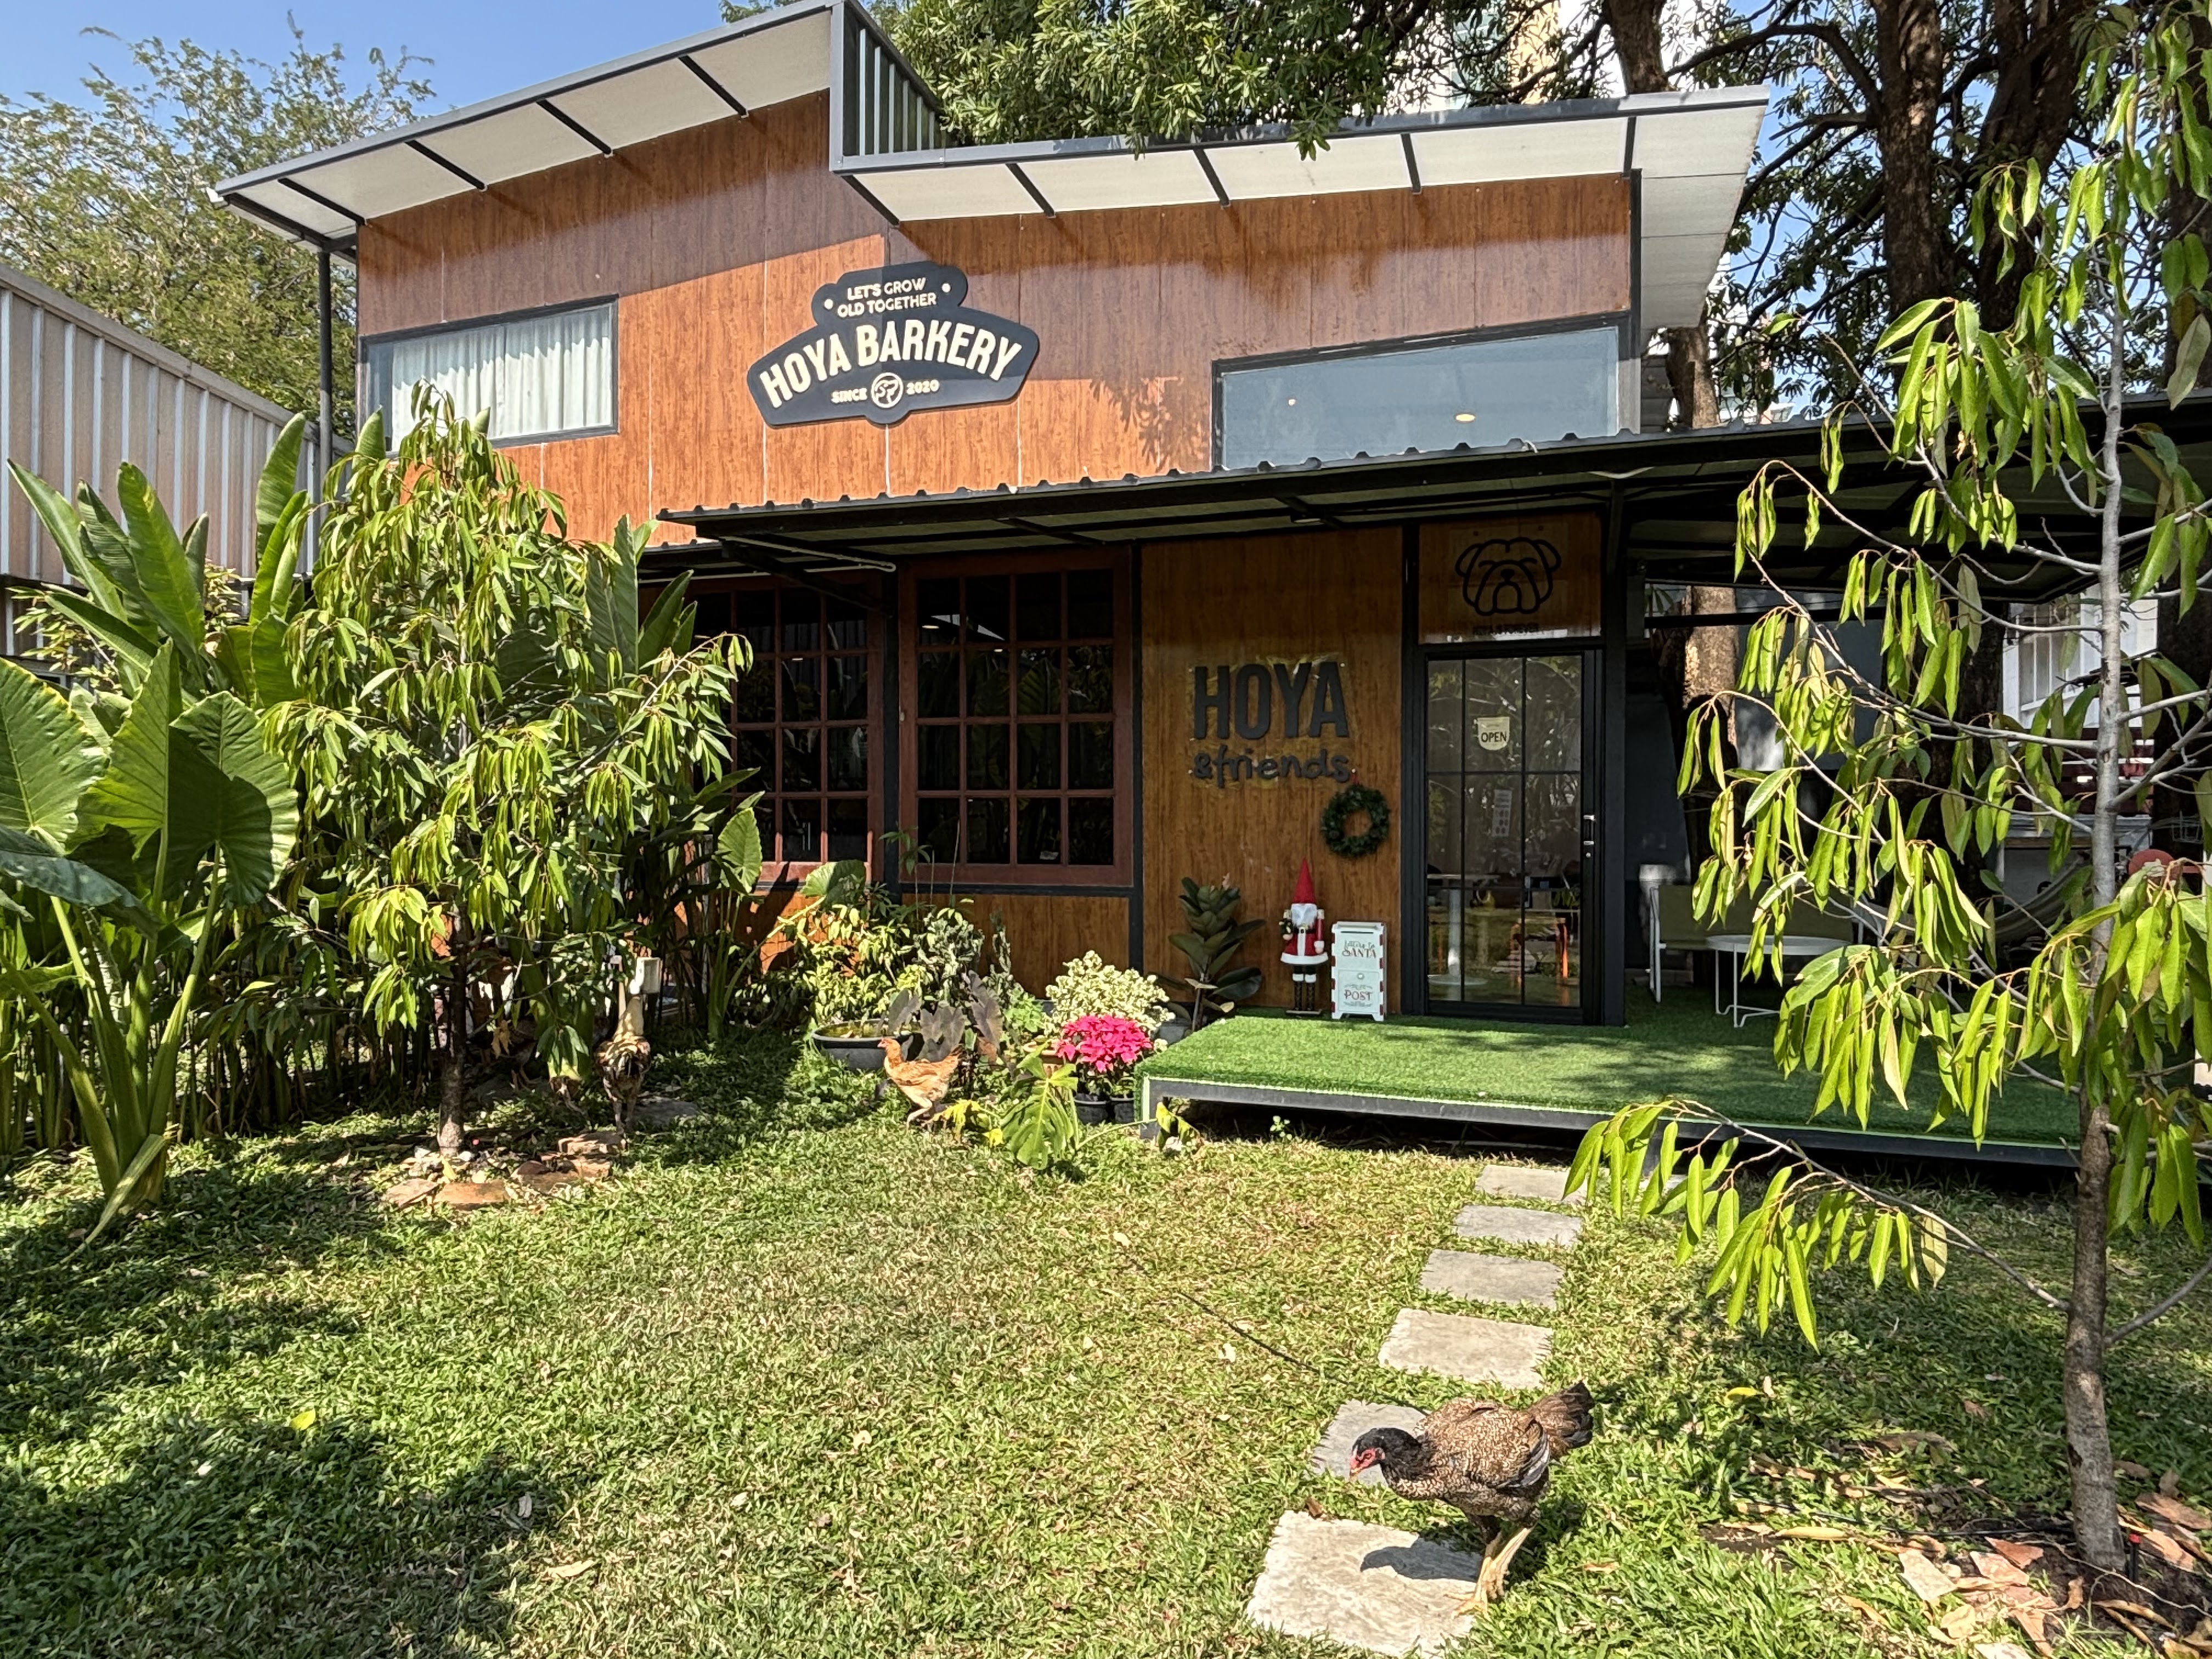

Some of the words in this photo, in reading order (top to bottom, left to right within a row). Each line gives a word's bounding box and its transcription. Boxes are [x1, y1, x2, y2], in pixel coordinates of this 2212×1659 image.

[847, 281, 881, 301] LET'S
[884, 277, 926, 295] GROW
[837, 297, 865, 318] OLD
[867, 292, 937, 314] TOGETHER
[759, 333, 852, 408] HOYA
[856, 319, 1023, 382] BARKERY
[831, 388, 868, 404] SINCE
[906, 380, 940, 395] 2020
[1194, 662, 1349, 740] HOYA
[1481, 731, 1507, 743] OPEN
[1194, 744, 1351, 789] &friends
[1342, 948, 1376, 958] SANTA
[1344, 989, 1373, 1001] POST
